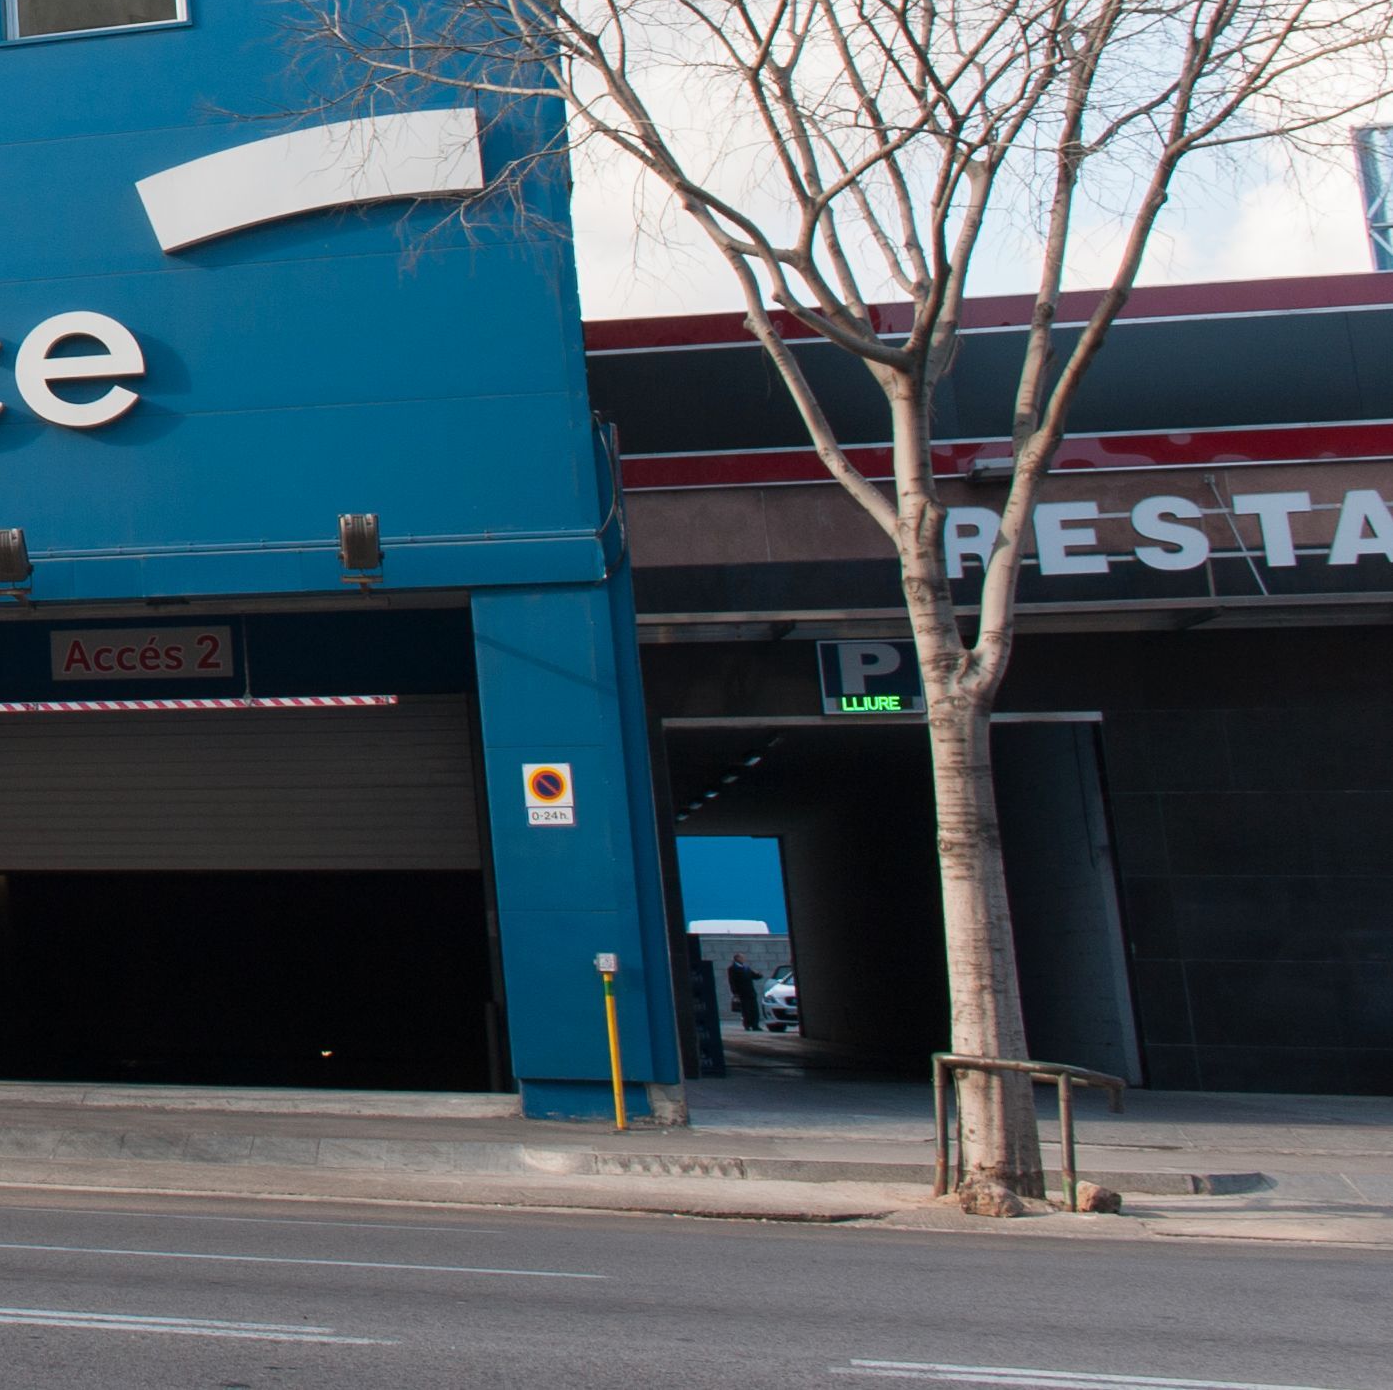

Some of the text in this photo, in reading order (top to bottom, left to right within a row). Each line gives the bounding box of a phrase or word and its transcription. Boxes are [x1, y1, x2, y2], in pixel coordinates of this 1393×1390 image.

[944, 490, 1393, 578] RESTA
[64, 635, 221, 672] Accés 2
[837, 643, 901, 694] P
[841, 696, 901, 711] LLIURE
